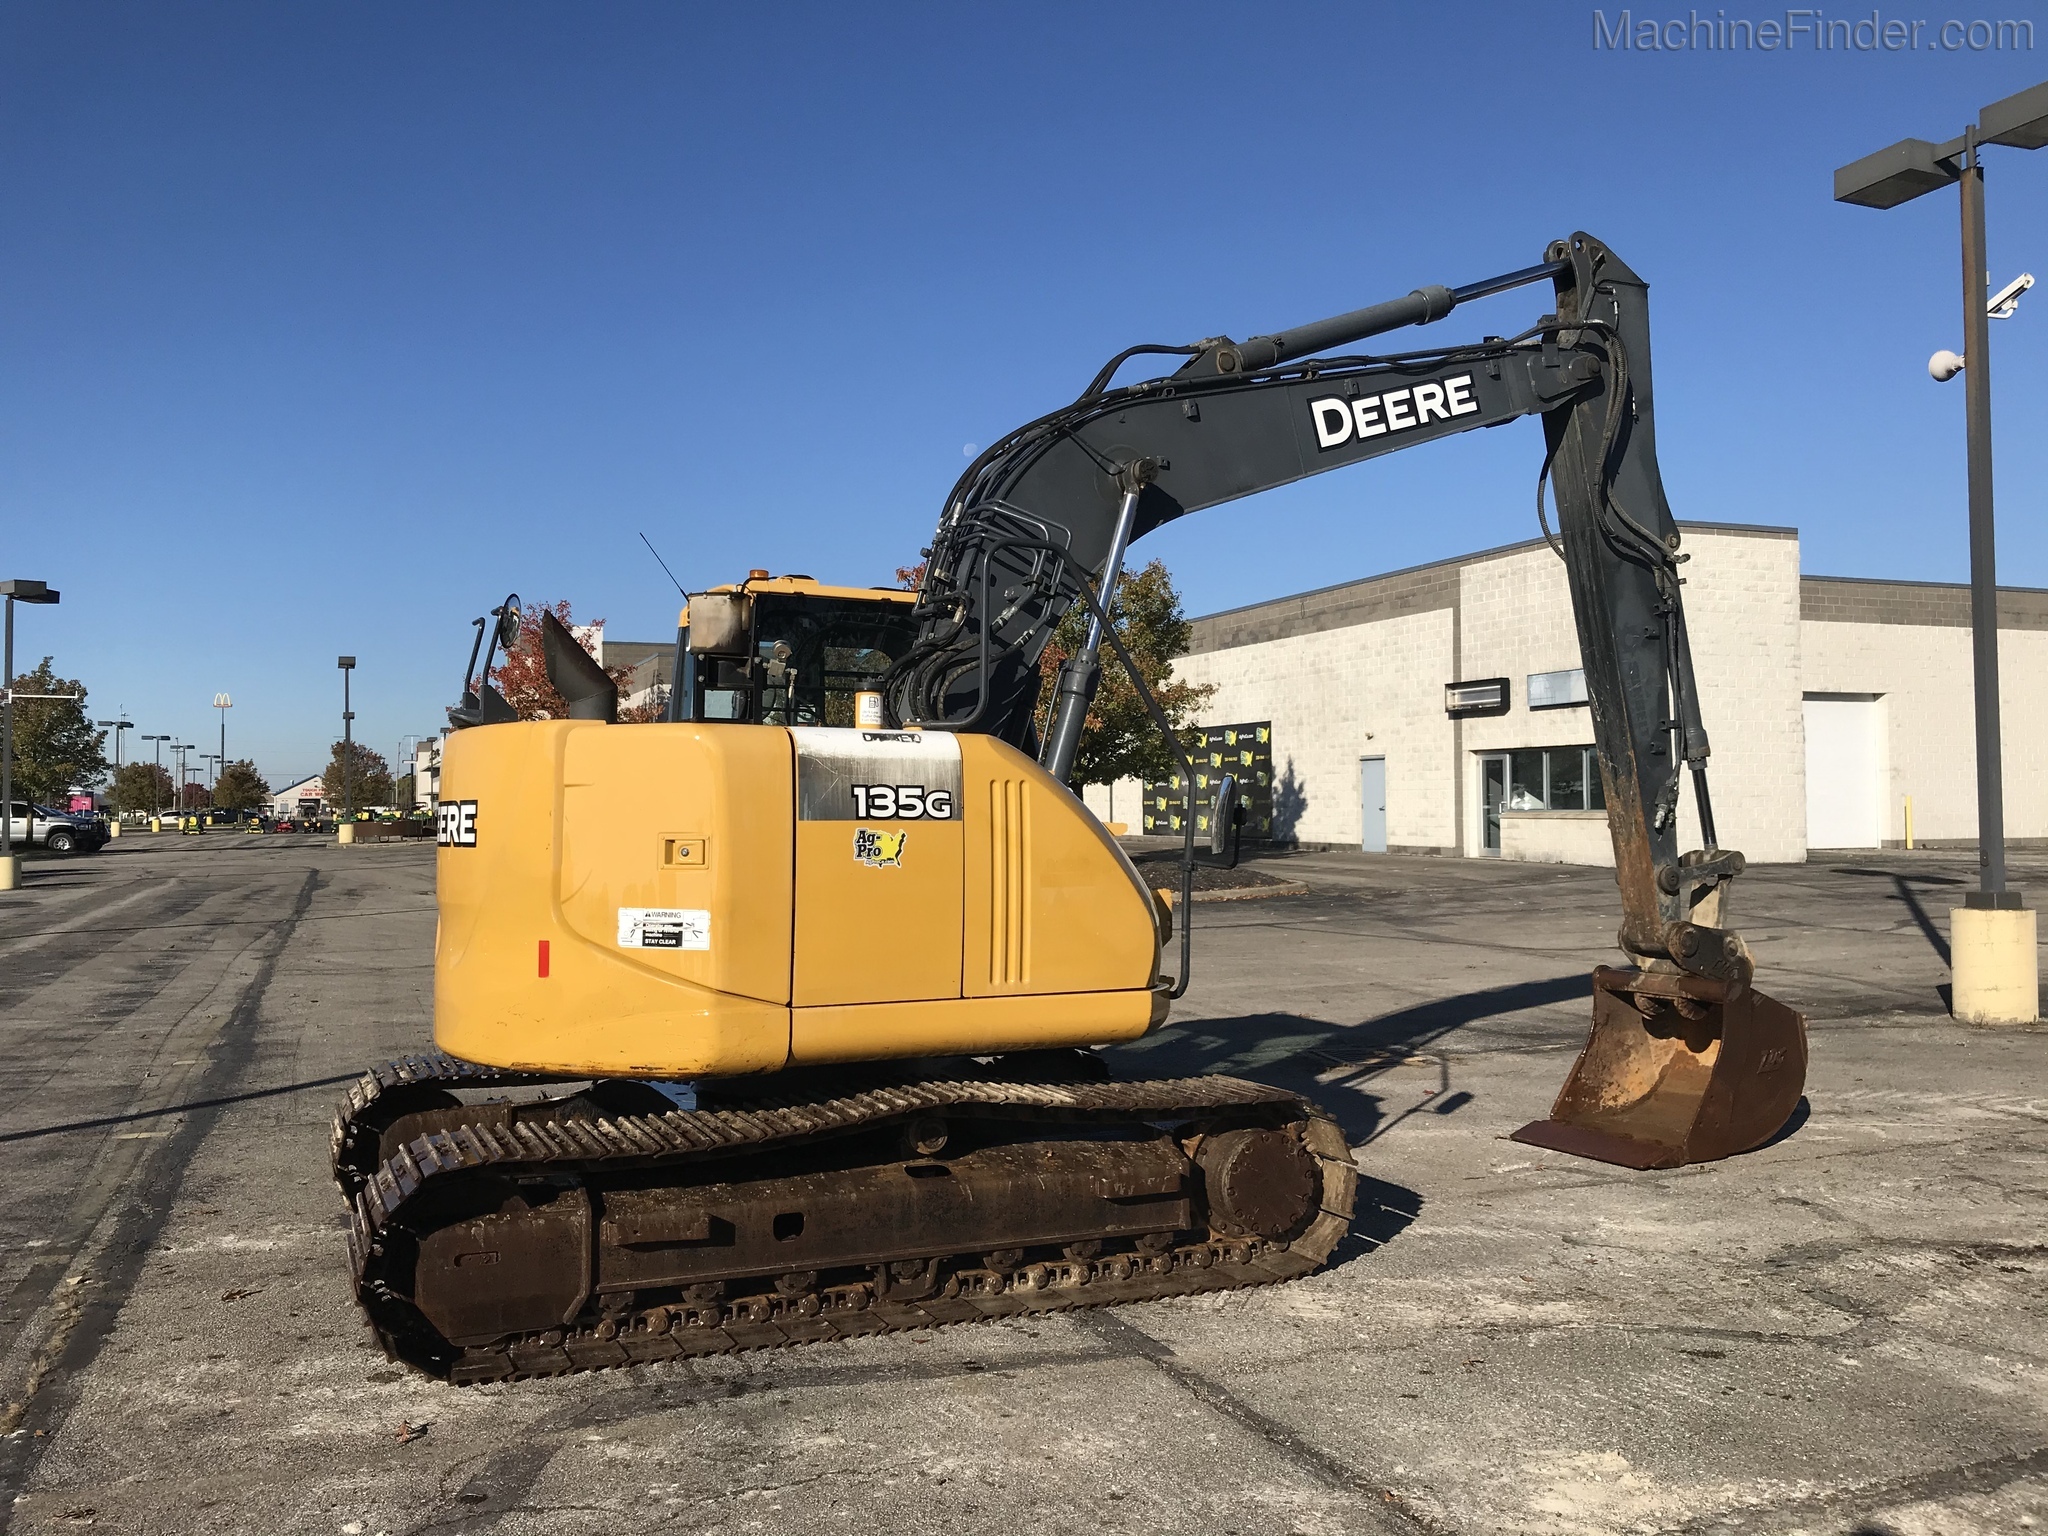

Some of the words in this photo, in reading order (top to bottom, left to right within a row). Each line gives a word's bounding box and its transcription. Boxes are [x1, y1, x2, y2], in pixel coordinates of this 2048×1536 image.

[1309, 373, 1480, 450] DEERE
[852, 786, 952, 819] 135G
[437, 802, 477, 844] ERE
[856, 830, 881, 846] Ag-
[856, 845, 882, 858] Pro
[651, 911, 682, 919] WARNING
